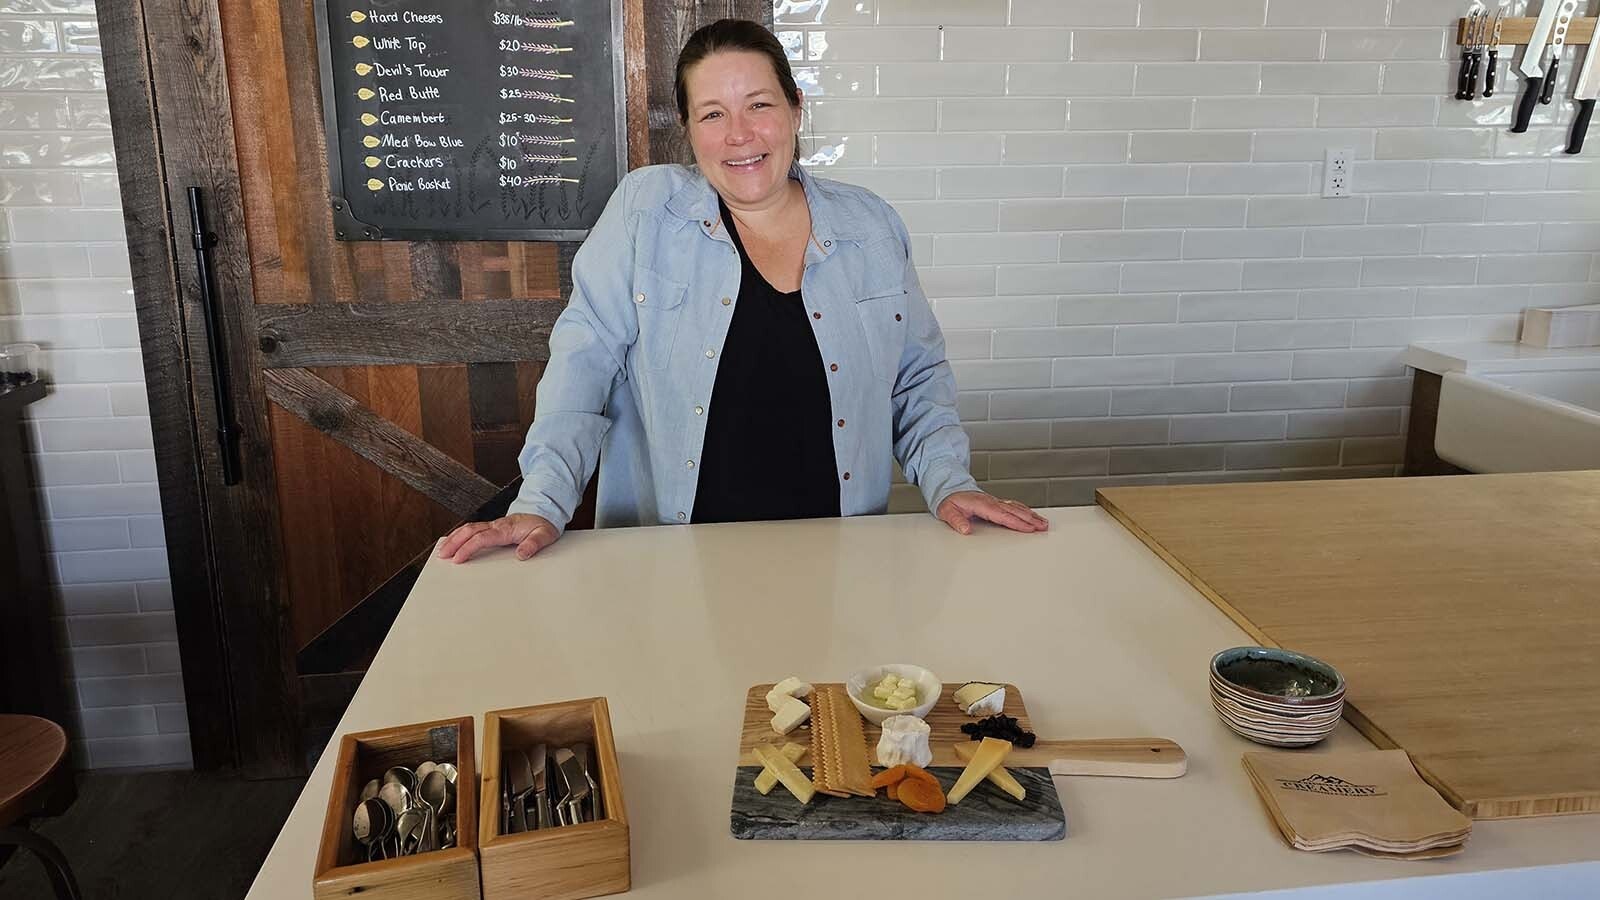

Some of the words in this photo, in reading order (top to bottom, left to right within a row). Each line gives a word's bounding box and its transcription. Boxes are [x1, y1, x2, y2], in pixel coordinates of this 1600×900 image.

[369, 10, 398, 24] Hard
[403, 11, 444, 24] Cheeses
[373, 36, 402, 50] White
[404, 36, 426, 54] Top
[499, 39, 520, 52] $20
[373, 62, 412, 76] Devil's
[414, 64, 450, 78] Tower
[499, 64, 519, 77] $30
[378, 86, 403, 102] Red
[408, 86, 440, 99] Butte
[500, 88, 522, 99] $25
[380, 110, 445, 125] Camembert
[382, 133, 409, 148] Med
[414, 134, 436, 148] Bow
[439, 136, 464, 148] Blue
[499, 132, 518, 147] $10
[386, 154, 444, 168] Crackers
[499, 156, 516, 170] $10
[388, 176, 414, 191] Picnic
[418, 178, 451, 190] Basket
[499, 174, 522, 187] $40
[1282, 782, 1376, 794] CREAMERY
